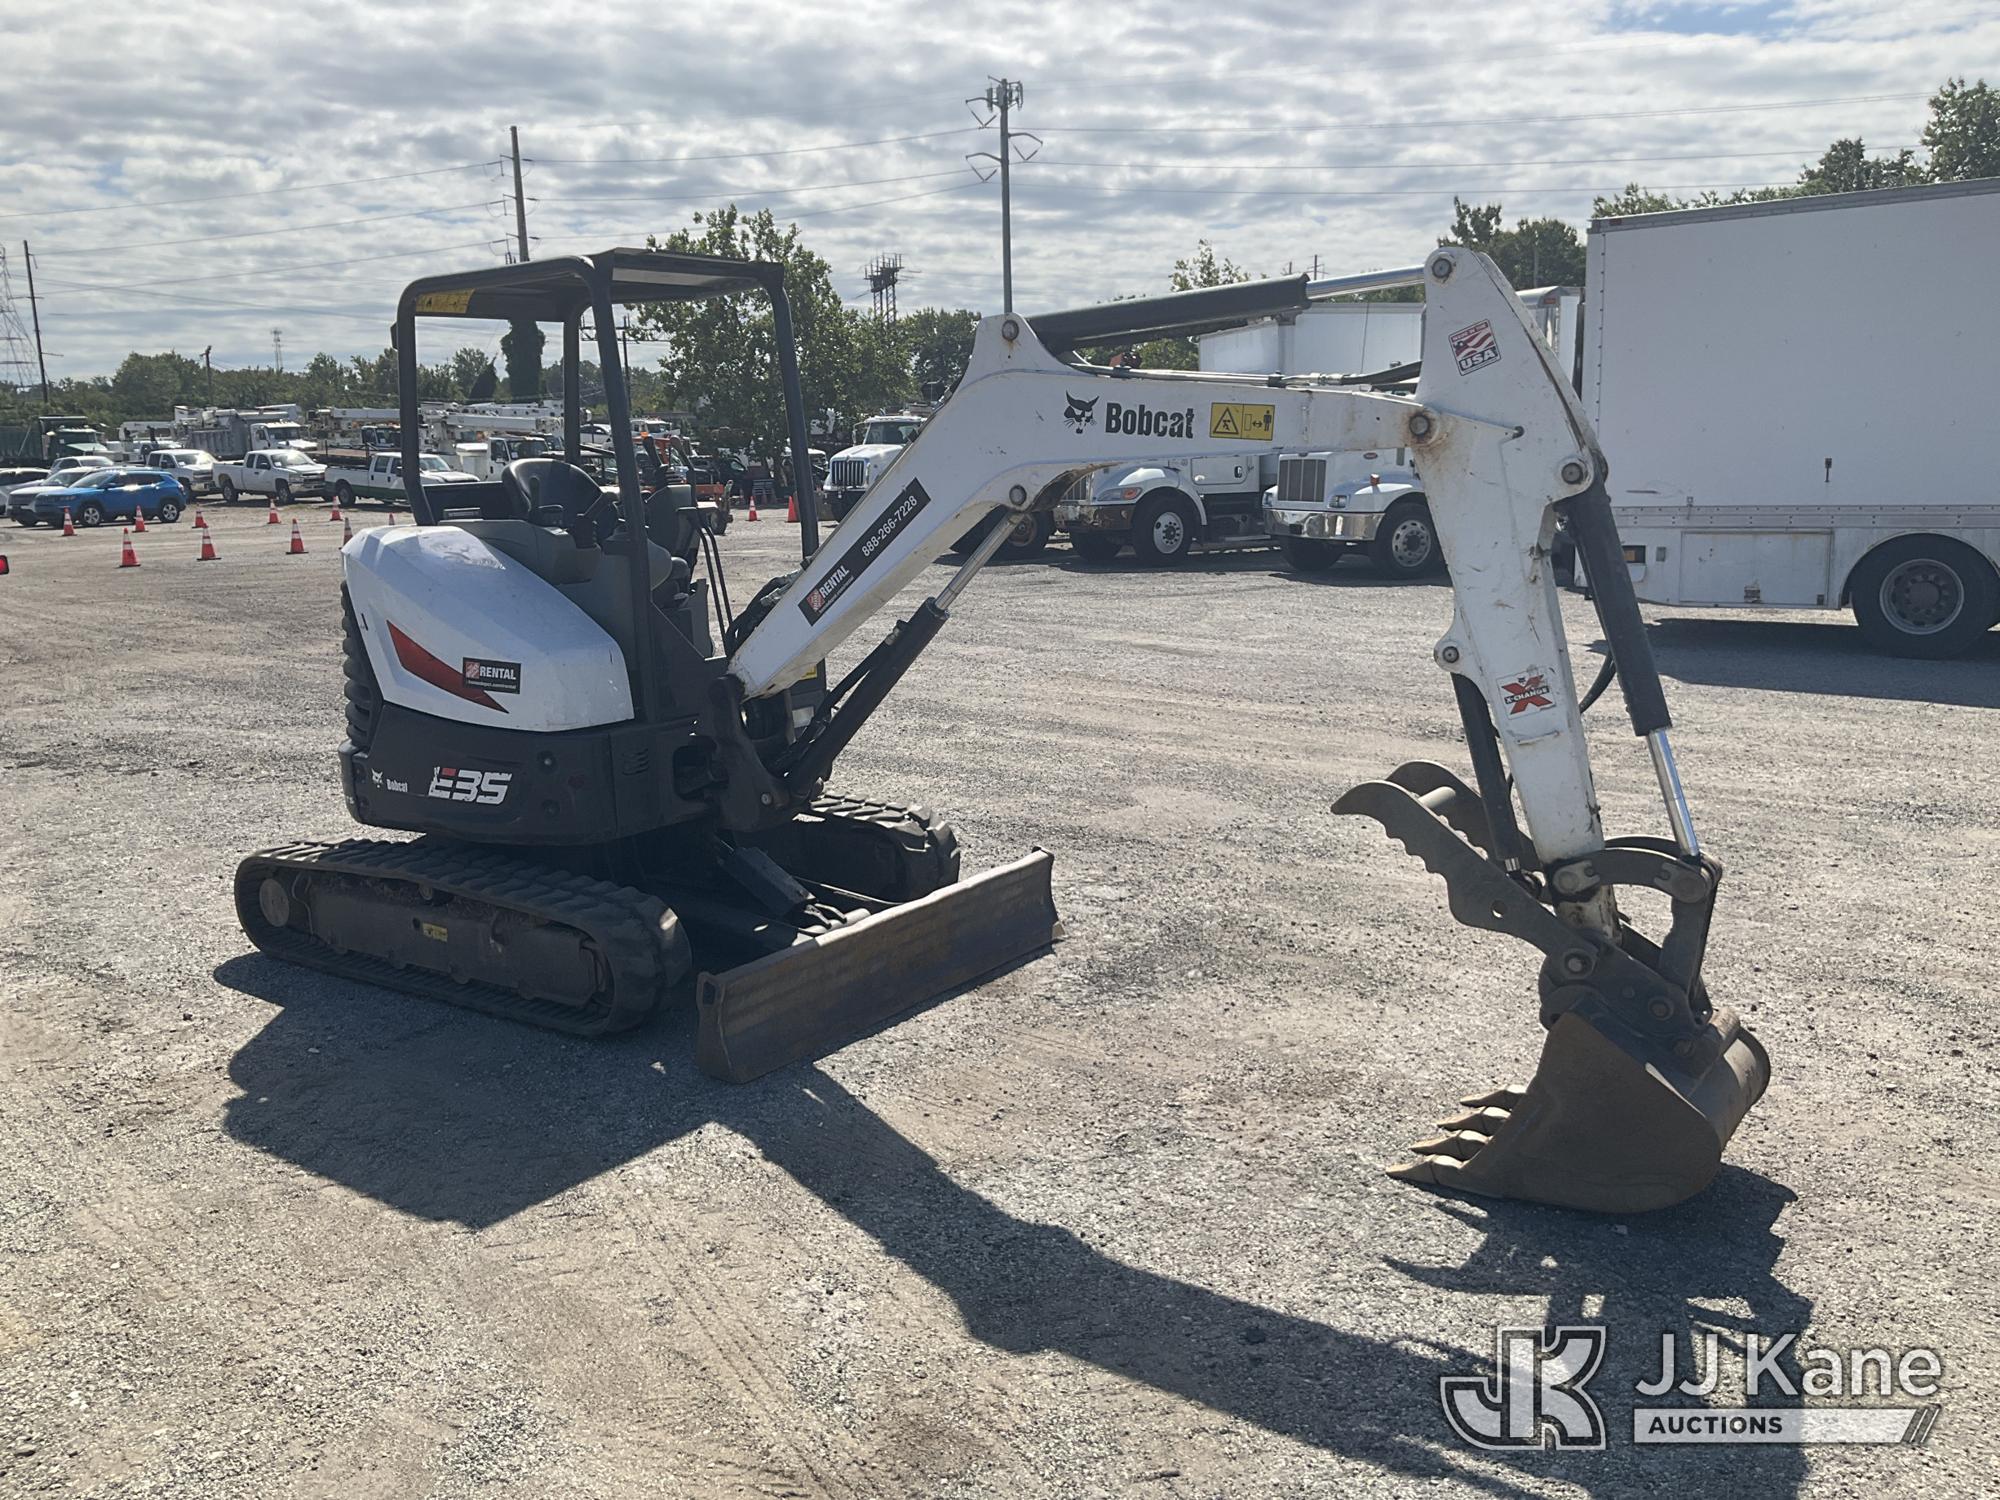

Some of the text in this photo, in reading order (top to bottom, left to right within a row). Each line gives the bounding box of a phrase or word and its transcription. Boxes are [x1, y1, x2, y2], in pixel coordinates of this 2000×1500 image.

[1461, 349, 1496, 369] USA
[1105, 402, 1194, 439] Bobcat
[861, 495, 918, 557] 888-266-7228
[819, 564, 850, 599] RENTAL
[480, 666, 517, 680] RENTAL
[1505, 686, 1549, 704] X-CHANGE
[386, 778, 409, 793] Bobcat
[428, 766, 513, 805] E35
